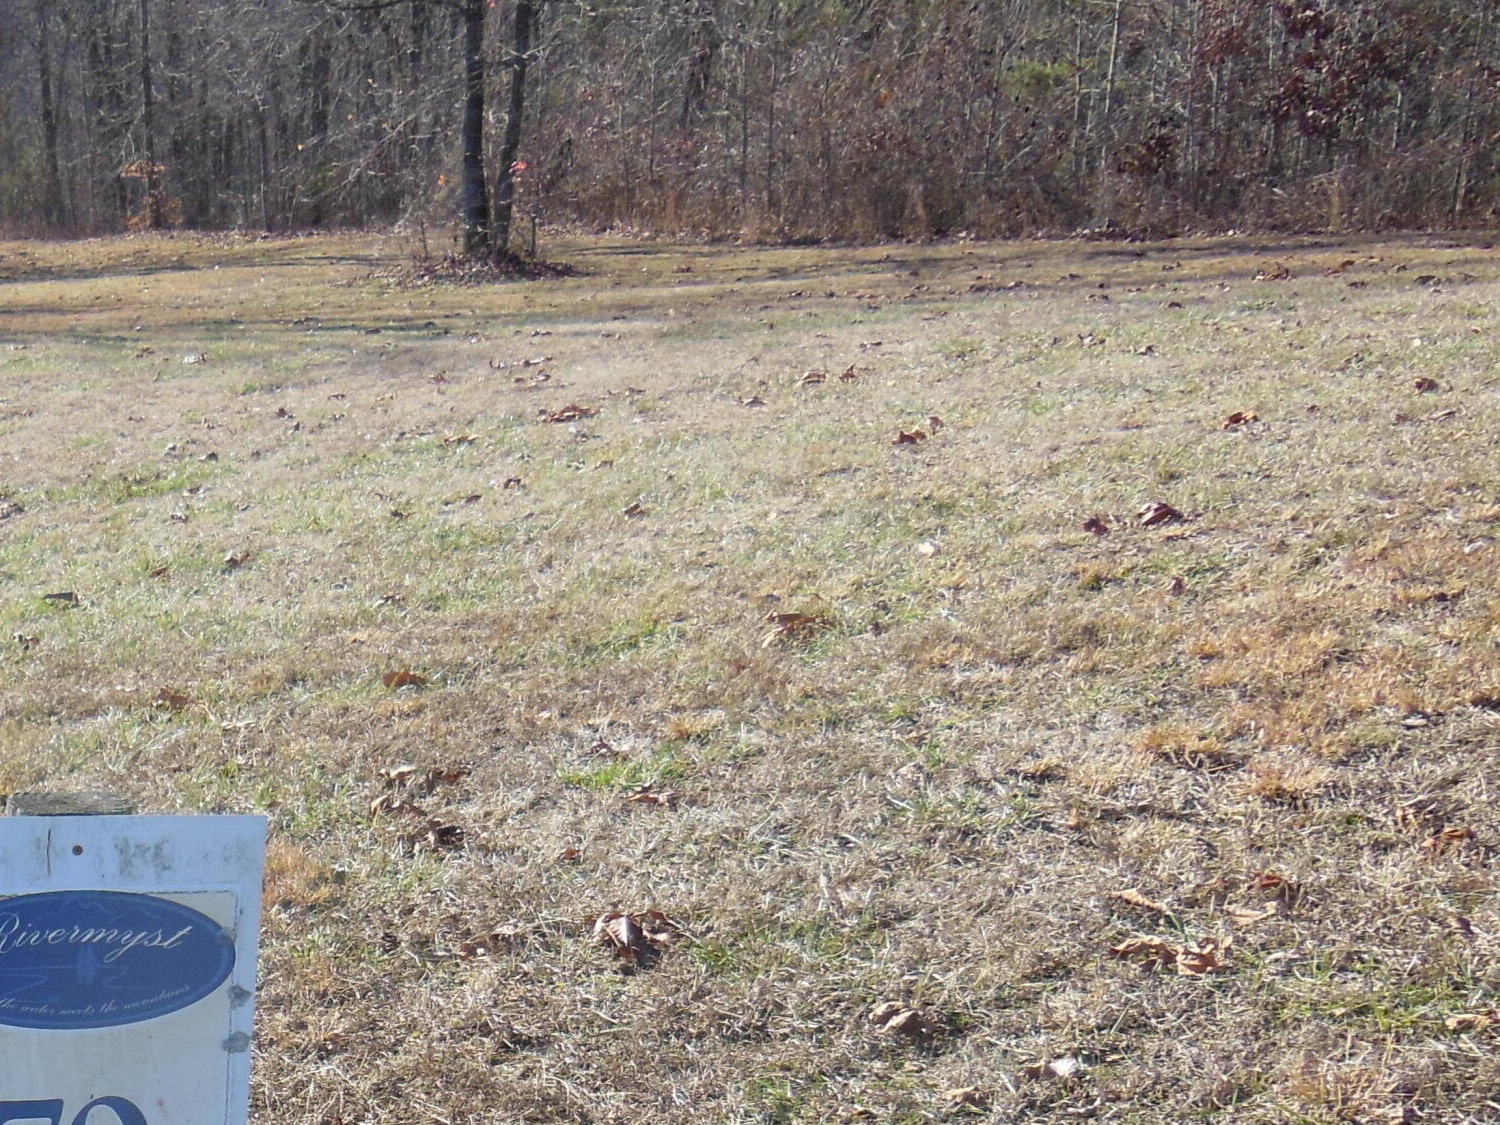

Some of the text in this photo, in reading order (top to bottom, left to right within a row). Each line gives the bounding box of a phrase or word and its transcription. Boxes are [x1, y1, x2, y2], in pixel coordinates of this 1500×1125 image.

[21, 1003, 56, 1015] water
[59, 1003, 95, 1016] meets
[100, 999, 118, 1014] the
